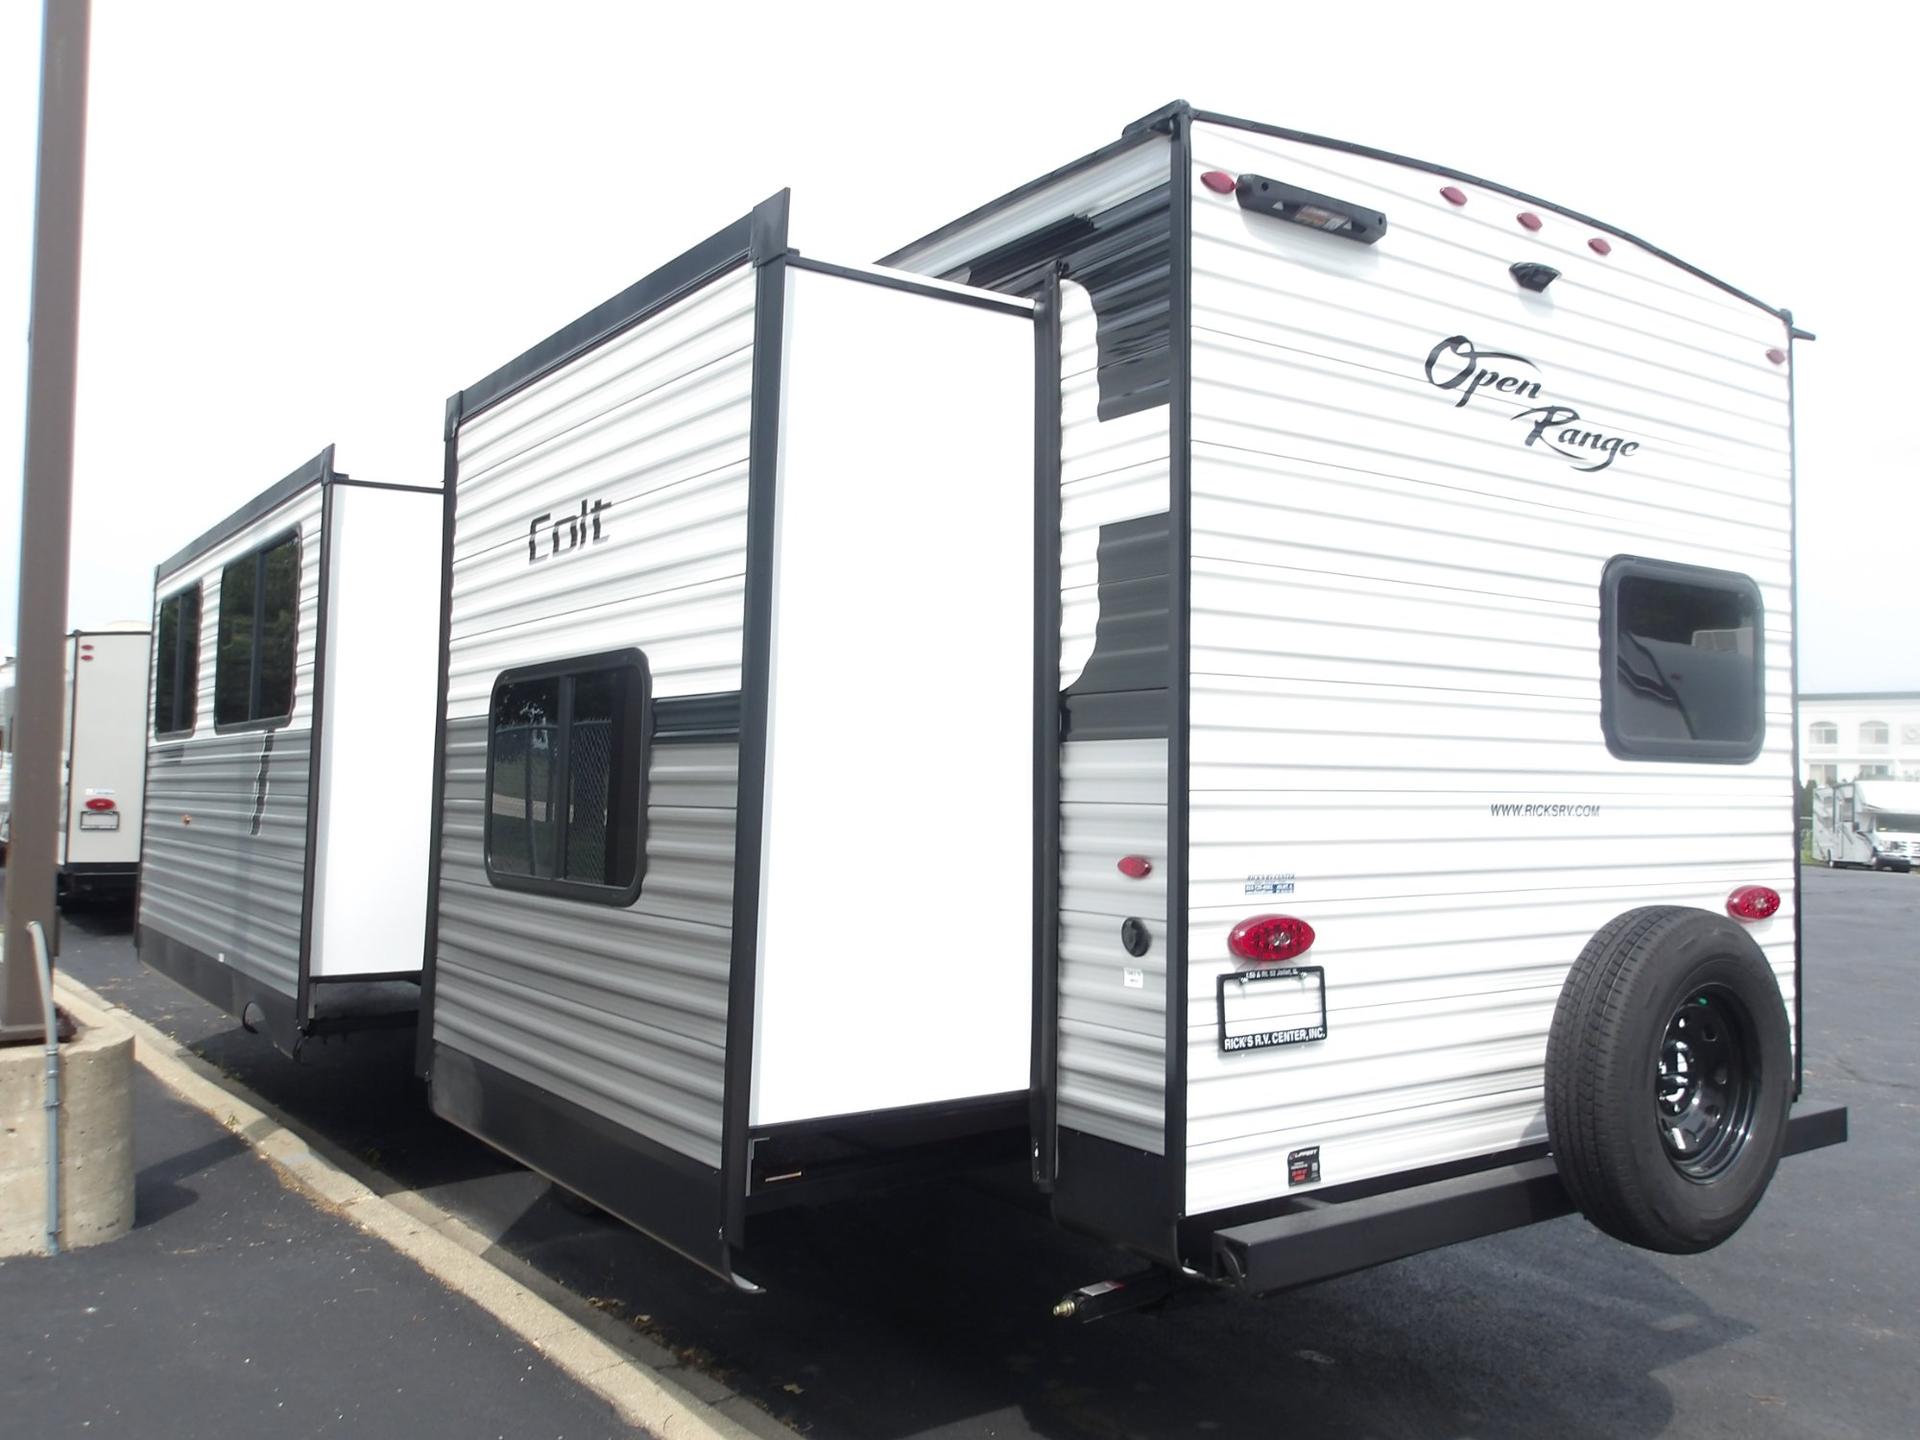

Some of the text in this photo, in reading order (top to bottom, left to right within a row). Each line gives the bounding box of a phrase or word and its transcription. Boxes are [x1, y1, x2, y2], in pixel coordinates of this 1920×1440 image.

[1425, 335, 1542, 408] Open
[1511, 405, 1640, 472] Range
[1490, 803, 1600, 817] WWW.RICKSRV.COM
[1224, 1035, 1254, 1050] RICK'S
[1255, 1033, 1271, 1047] R.V.
[1308, 1027, 1326, 1039] INC.
